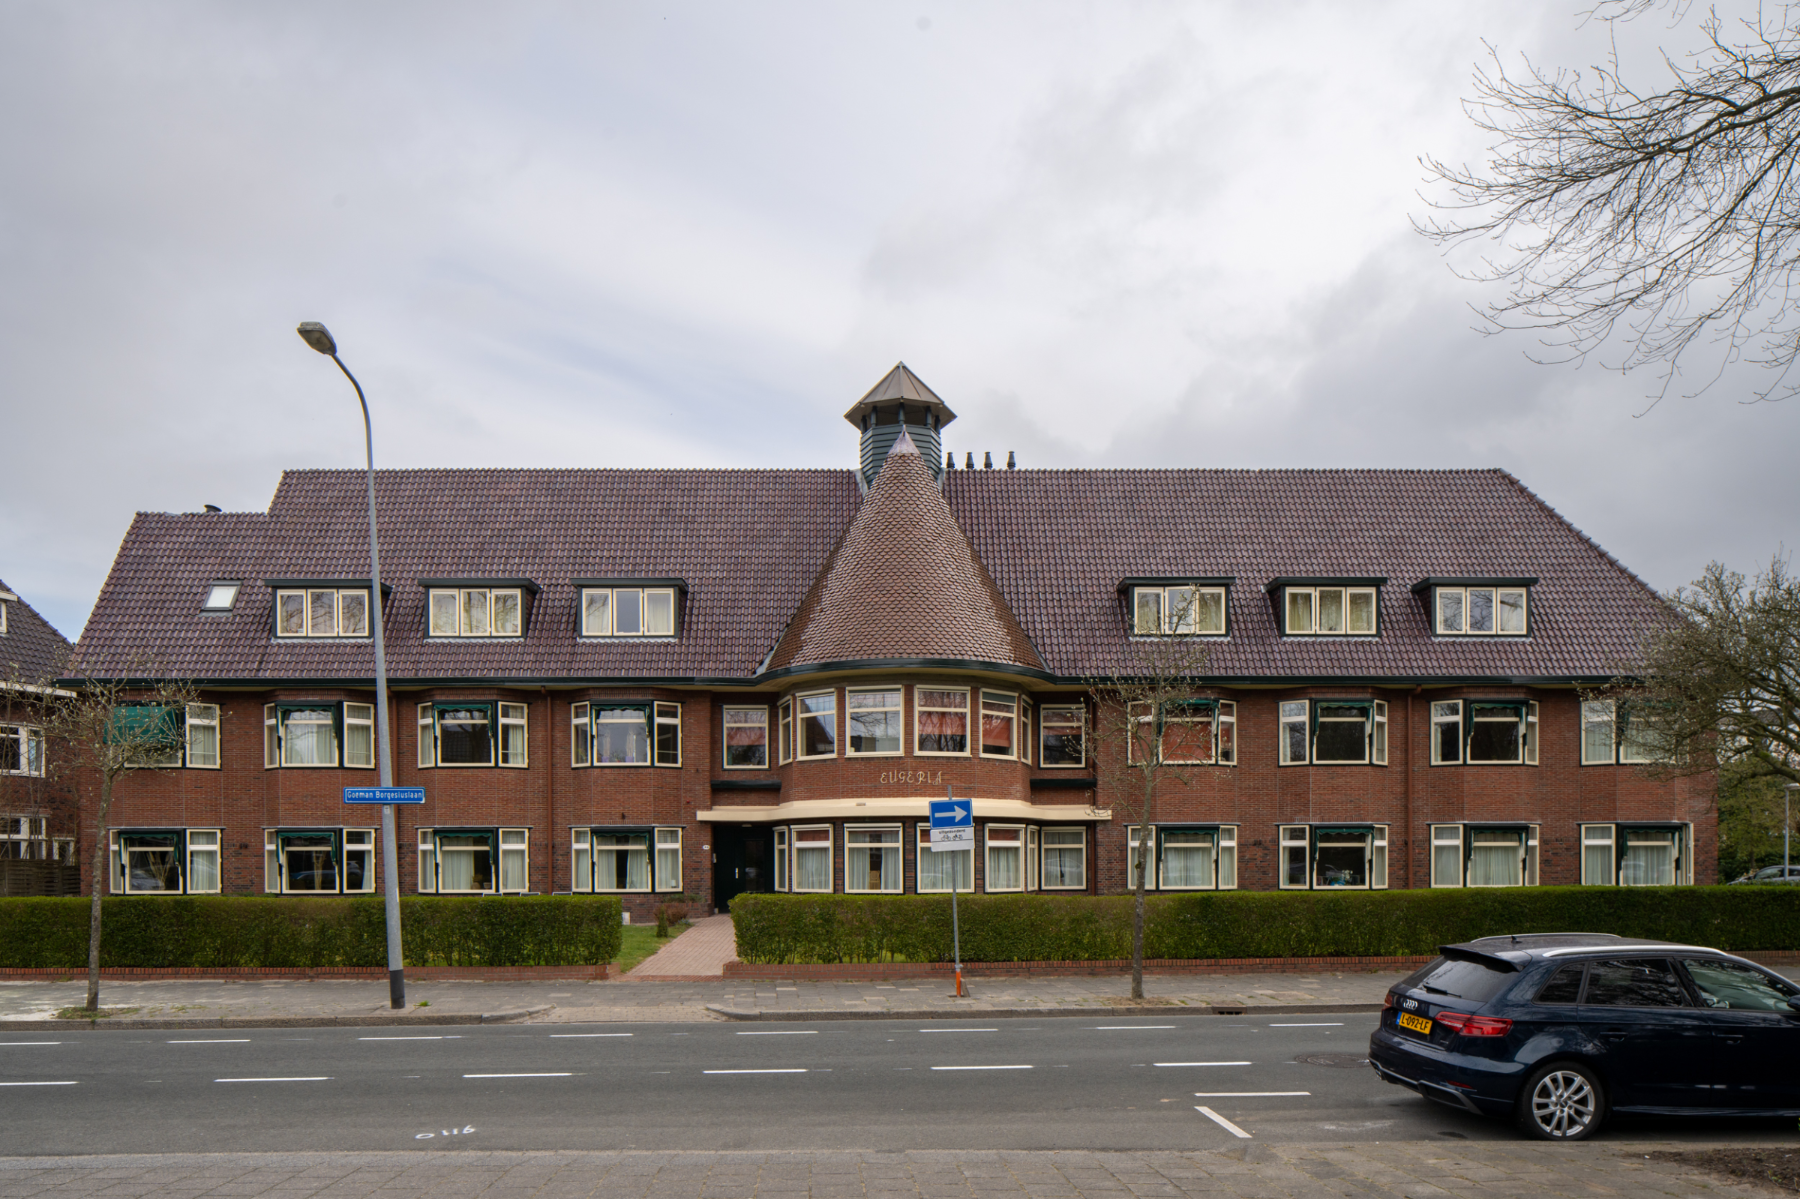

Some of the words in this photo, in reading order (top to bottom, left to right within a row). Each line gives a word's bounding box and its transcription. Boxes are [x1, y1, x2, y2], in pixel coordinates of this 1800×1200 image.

[880, 769, 943, 785] EUGERIA
[347, 790, 374, 799] Goeman
[375, 790, 423, 800] Borgesiuslaan
[1400, 1012, 1430, 1031] L-092-LF
